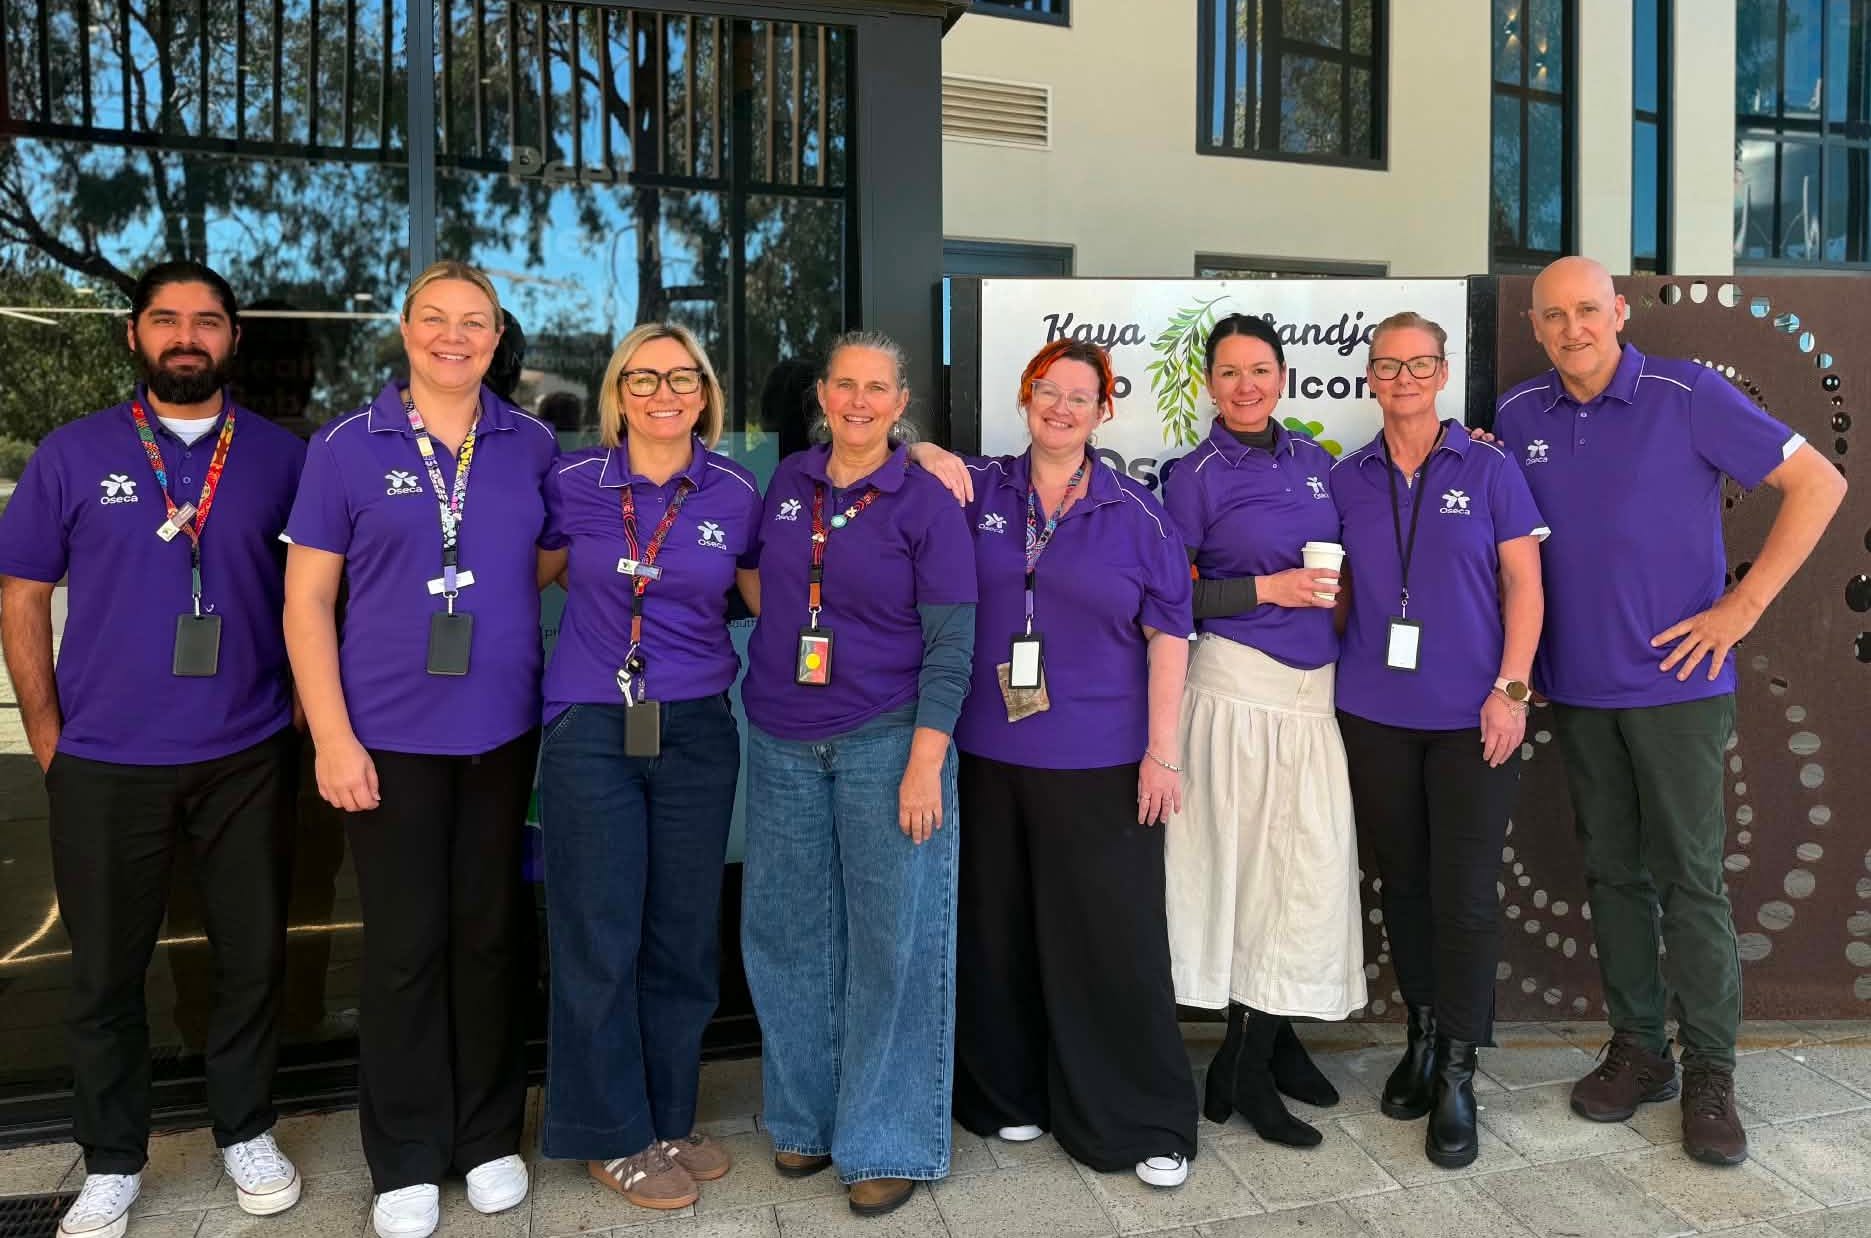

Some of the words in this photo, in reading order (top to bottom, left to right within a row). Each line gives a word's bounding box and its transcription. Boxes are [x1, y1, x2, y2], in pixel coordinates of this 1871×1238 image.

[1043, 312, 1146, 353] Kaya
[387, 487, 424, 496] Oseca
[100, 495, 139, 505] Oseca
[1439, 507, 1471, 516] Oseca
[697, 539, 727, 551] Oseca
